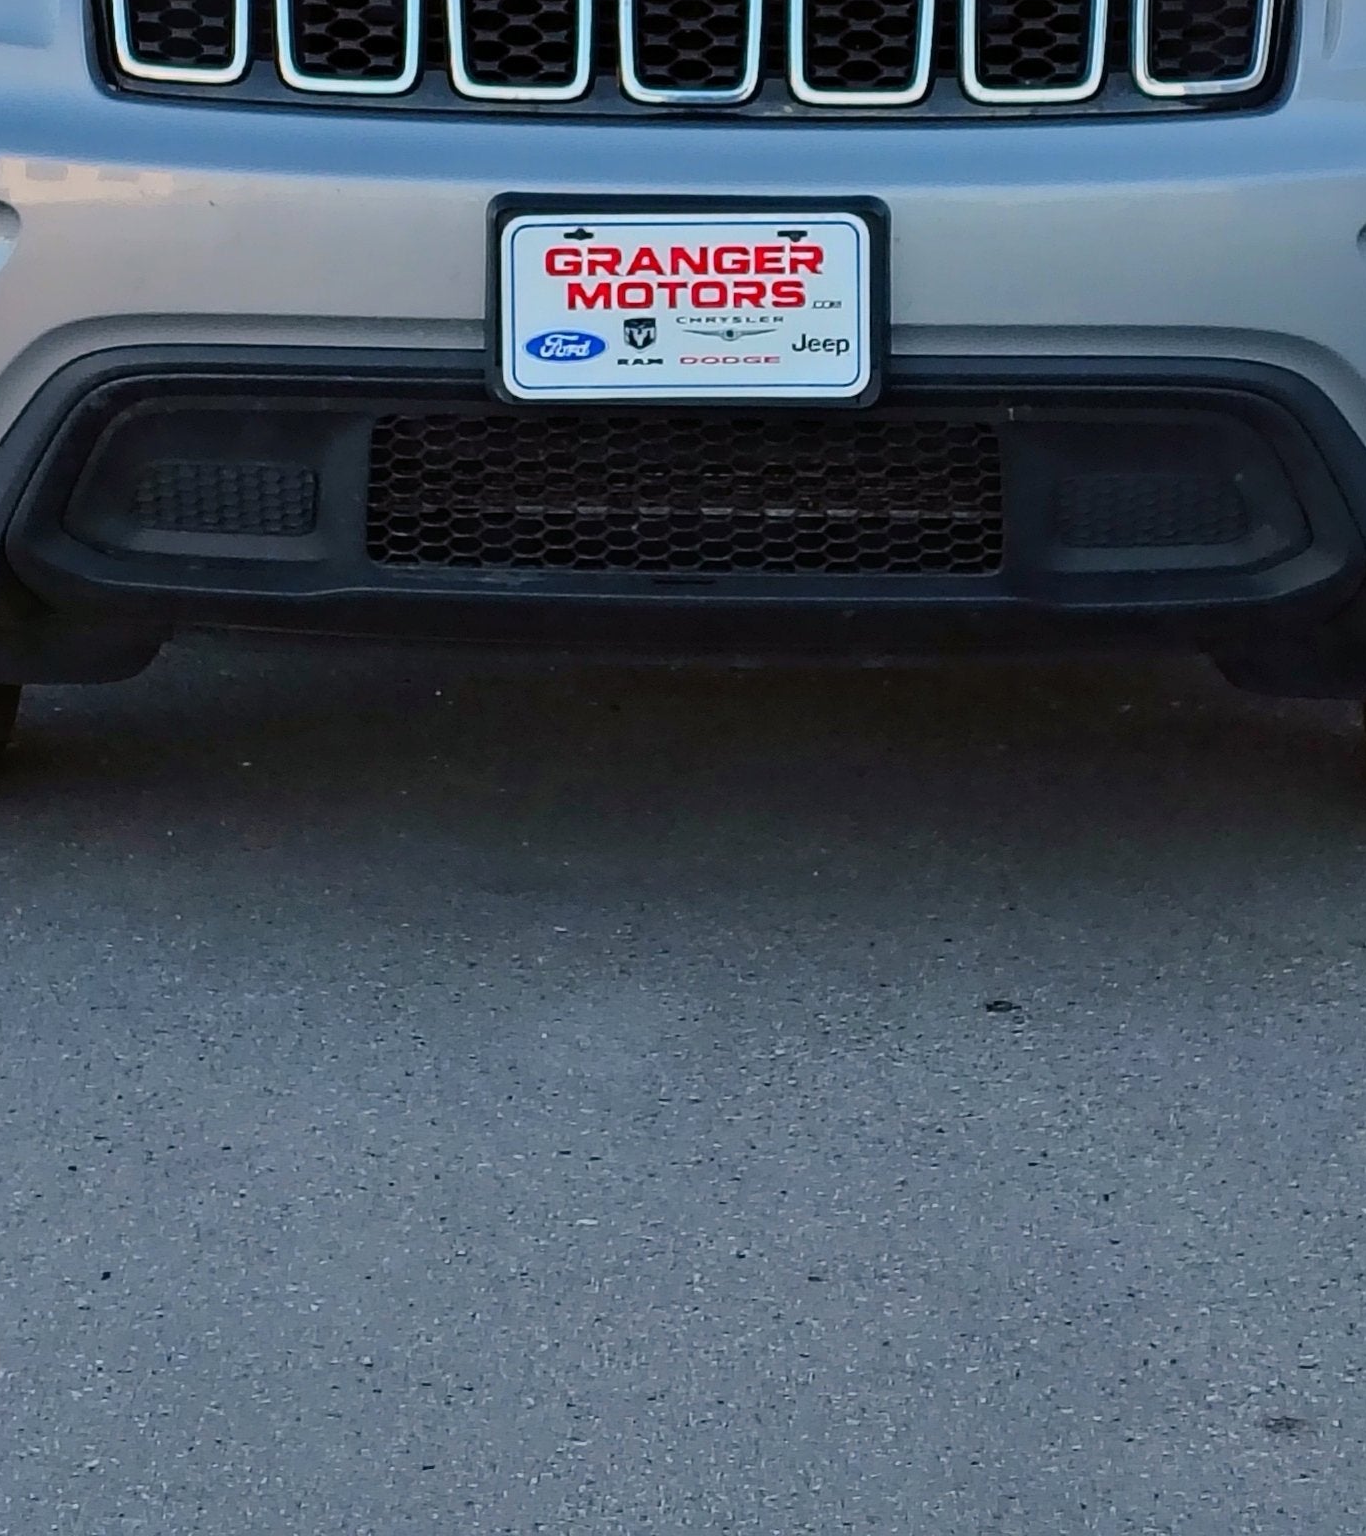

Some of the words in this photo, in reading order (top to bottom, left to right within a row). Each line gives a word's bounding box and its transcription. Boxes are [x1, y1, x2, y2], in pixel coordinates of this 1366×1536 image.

[544, 243, 824, 277] GRANGER
[566, 280, 807, 311] MOTORS
[676, 316, 784, 325] CHRYSLER
[539, 333, 592, 359] Ford
[791, 333, 851, 357] Jeep
[617, 358, 664, 366] RAM
[679, 356, 782, 365] DODGE
